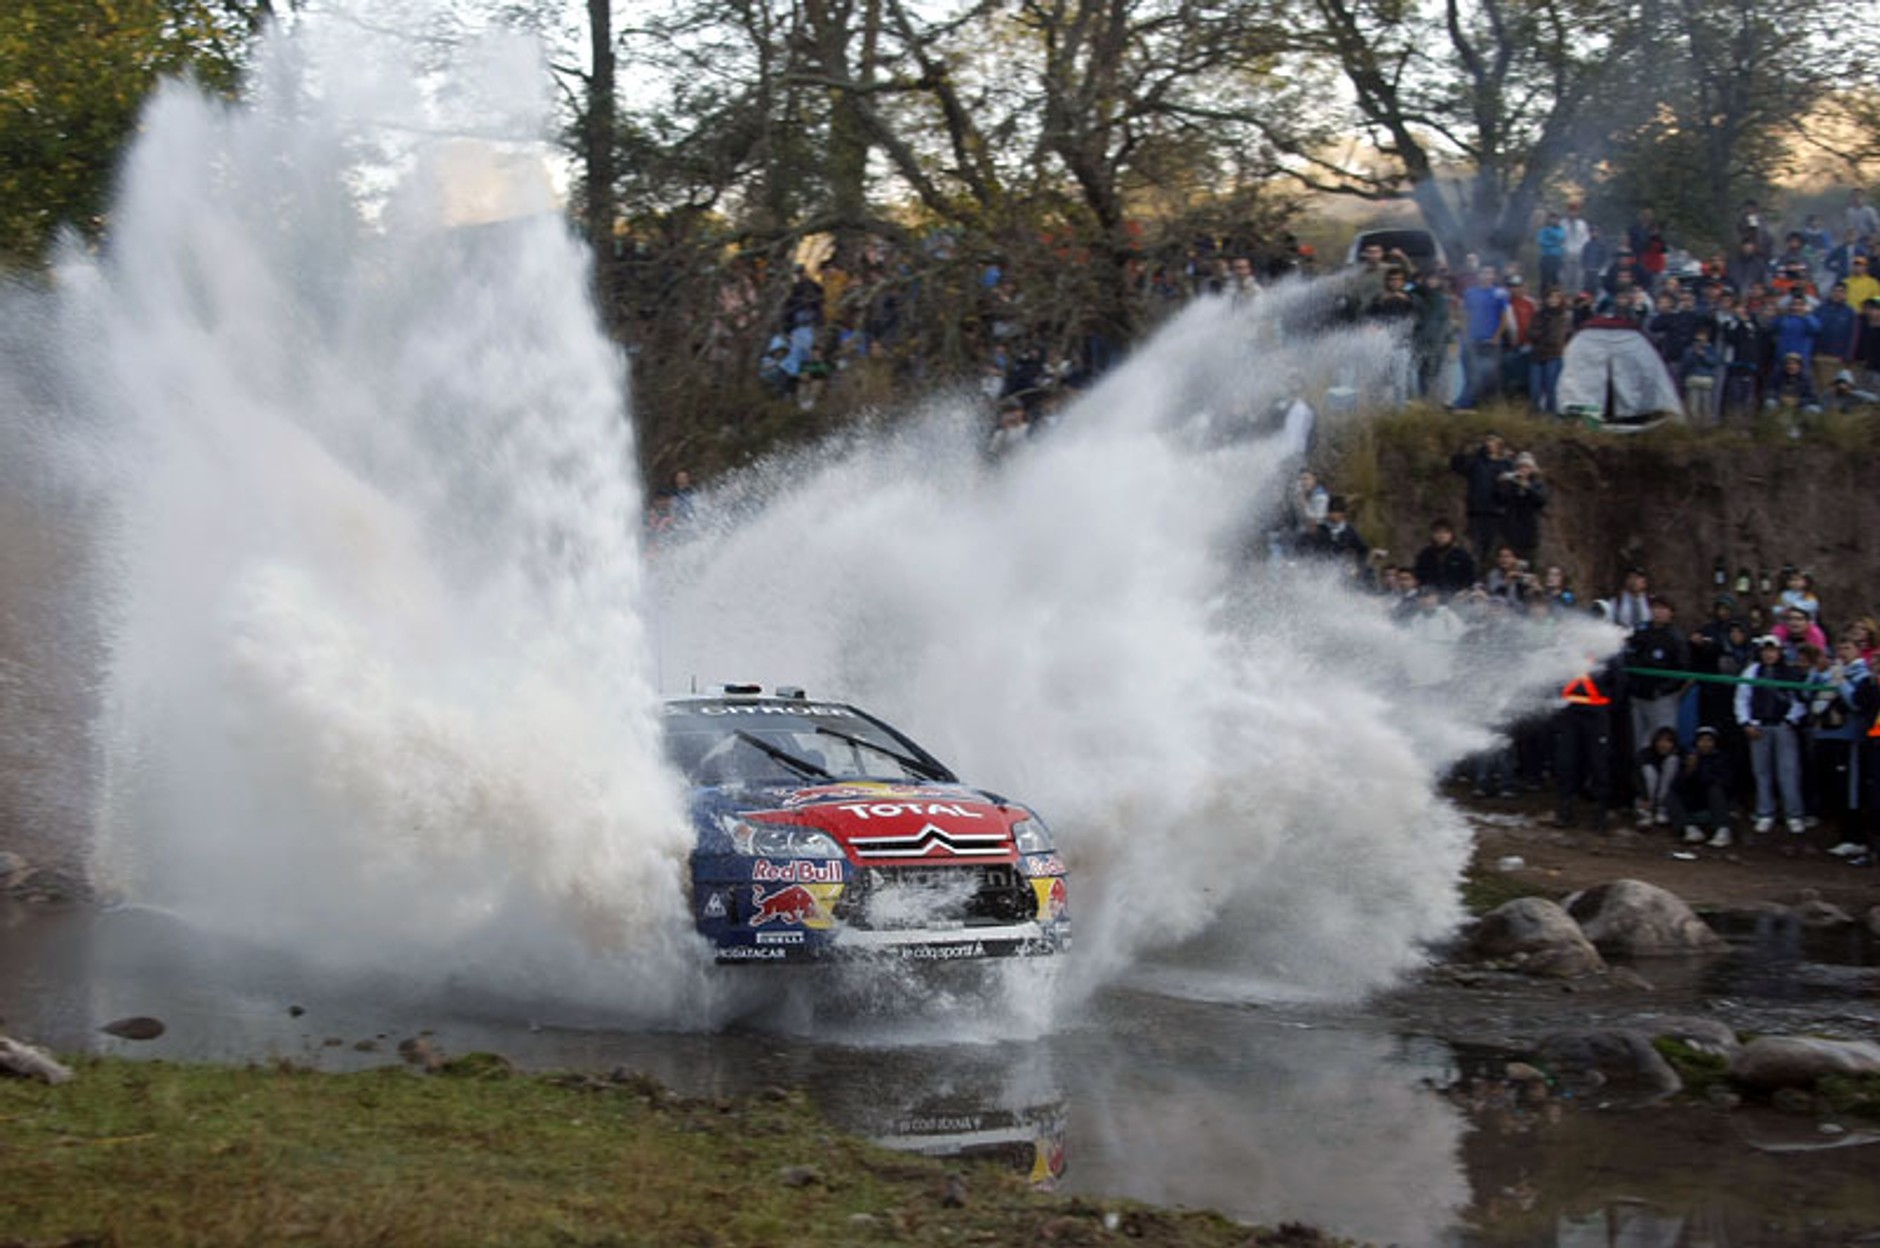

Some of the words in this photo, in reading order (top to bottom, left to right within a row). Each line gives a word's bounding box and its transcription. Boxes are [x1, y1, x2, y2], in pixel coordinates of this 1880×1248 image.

[838, 803, 983, 819] TOTAL
[752, 859, 795, 880] Red
[796, 860, 843, 882] Bull
